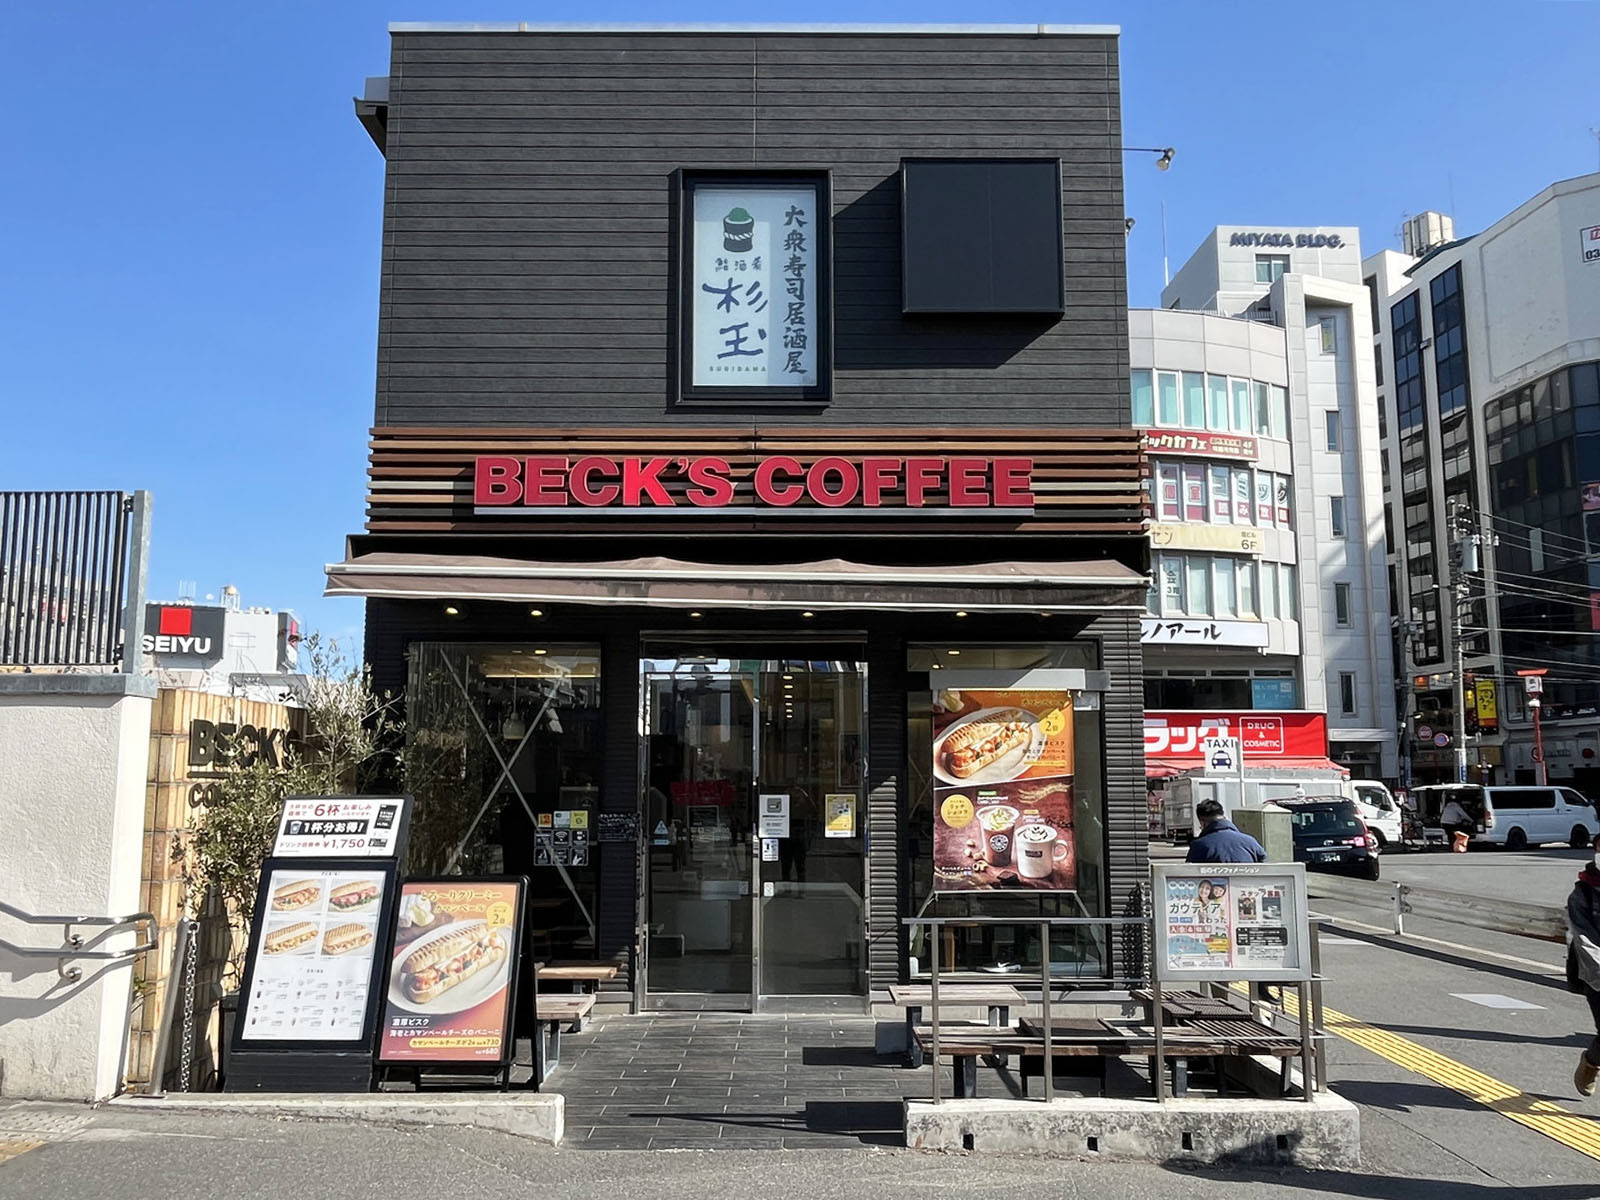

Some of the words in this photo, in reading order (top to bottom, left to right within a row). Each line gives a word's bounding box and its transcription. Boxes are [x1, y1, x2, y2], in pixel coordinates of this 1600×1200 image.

[1229, 231, 1294, 248] MIYATA
[783, 204, 809, 375] 大衆寿司居酒屋
[701, 277, 768, 360] 杉玉
[474, 457, 737, 507] BECK'S
[754, 457, 1036, 507] COFFEE
[1241, 540, 1257, 550] 6F
[142, 635, 211, 654] SEIYU
[1207, 739, 1234, 748] TAXI
[314, 804, 340, 816] 6杯
[323, 839, 365, 849] ¥1,750
